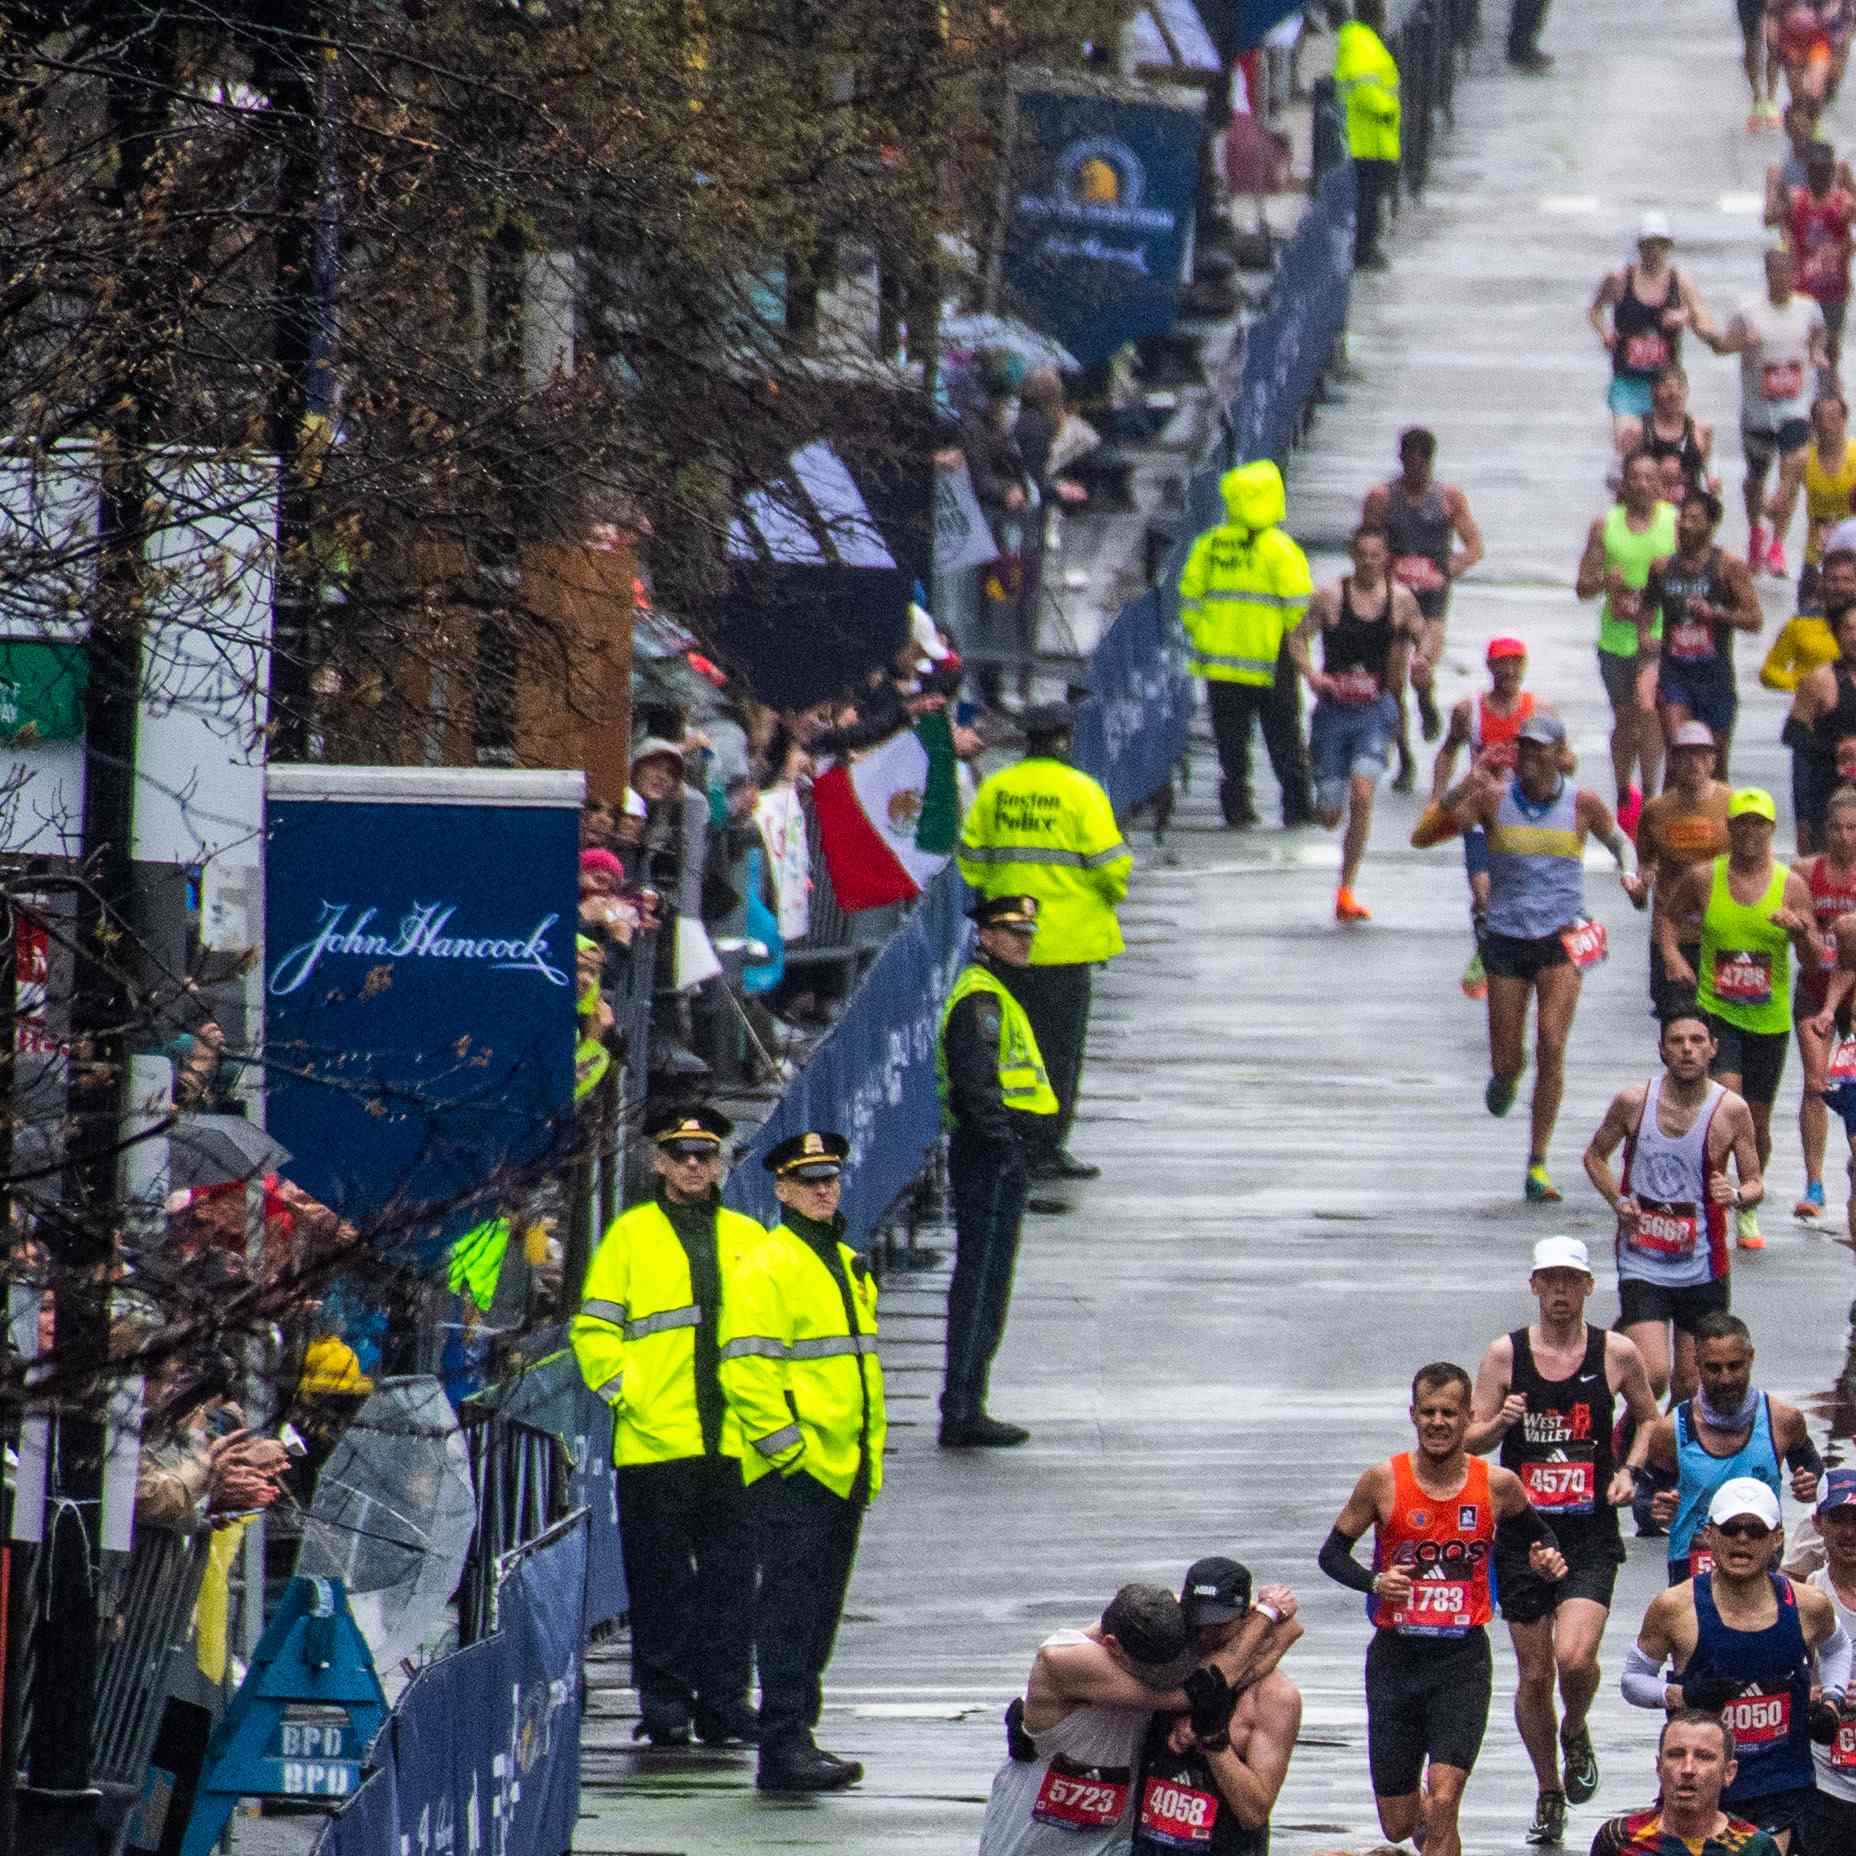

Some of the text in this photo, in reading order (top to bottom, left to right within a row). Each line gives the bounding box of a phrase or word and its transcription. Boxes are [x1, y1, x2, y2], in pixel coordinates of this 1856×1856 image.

[995, 790, 1061, 812] Boston
[994, 809, 1059, 834] Police
[270, 901, 569, 995] John Hancock
[1525, 1413, 1563, 1430] WEST
[1525, 1427, 1572, 1442] VALLEY
[1530, 1469, 1585, 1494] 4570
[1405, 1586, 1464, 1613] 1783
[1722, 1703, 1783, 1730] 4050
[281, 1726, 342, 1757] BPD
[283, 1764, 347, 1794] BPD
[1050, 1775, 1114, 1812] 5723
[1150, 1786, 1207, 1825] 4058
